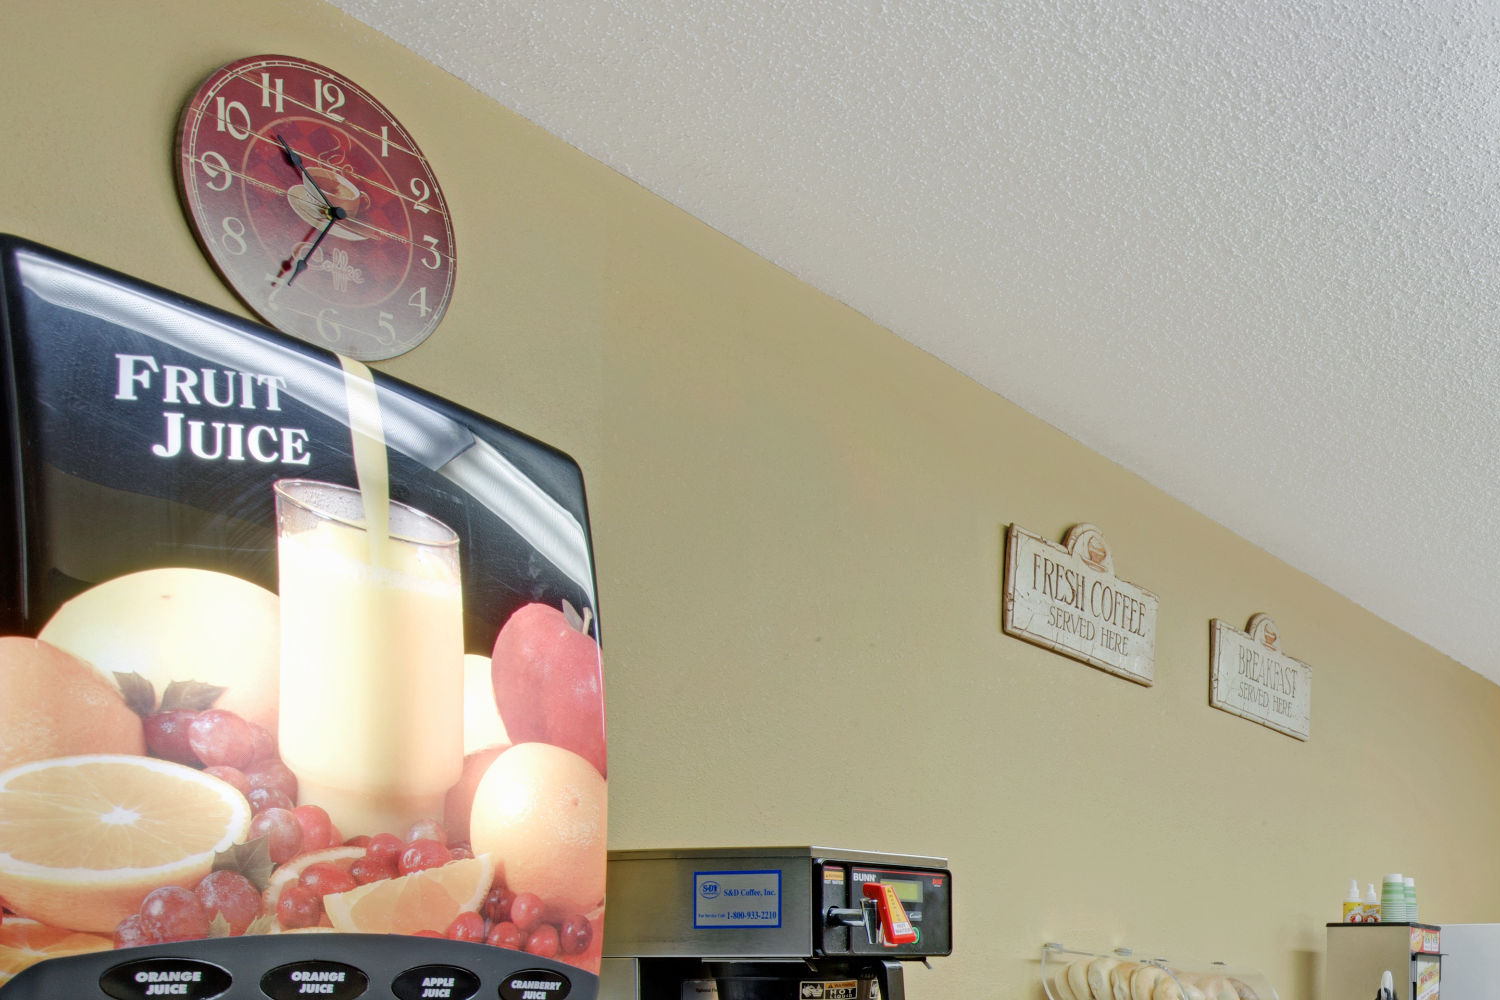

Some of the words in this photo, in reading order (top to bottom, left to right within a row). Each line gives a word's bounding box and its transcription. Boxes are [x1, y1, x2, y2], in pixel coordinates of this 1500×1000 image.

[261, 73, 284, 112] 11
[314, 79, 346, 122] 12
[216, 96, 251, 140] 10
[381, 126, 389, 157] 1
[201, 151, 233, 191] 9
[410, 177, 430, 213] 2
[222, 216, 247, 255] 8
[421, 234, 441, 269] 3
[408, 287, 432, 317] 4
[316, 307, 342, 342] 6
[378, 311, 397, 345] 5
[115, 353, 287, 412] FRUIT
[153, 412, 311, 466] JUICE
[1032, 553, 1086, 612] FRESH
[1090, 580, 1146, 638] COFFEE
[1048, 605, 1096, 642] SERVED
[1101, 626, 1129, 657] HERE
[1238, 644, 1298, 699] BREAKFAST
[1237, 681, 1270, 709] SERVED
[1272, 694, 1293, 719] HERE
[723, 889, 740, 897] S&D
[741, 888, 763, 898] Coffee,
[764, 888, 777, 897] Inc.
[853, 872, 875, 882] BUNN
[727, 911, 777, 920] 1-800-933-2210
[135, 971, 202, 983] ORANGE
[145, 982, 188, 996] JUICE
[291, 971, 346, 983] ORANGE
[299, 982, 335, 995] JUICE
[421, 988, 451, 999] JUICE
[422, 976, 455, 989] APPLE
[511, 979, 562, 992] CRANBERRY
[521, 990, 547, 1000] JUICE
